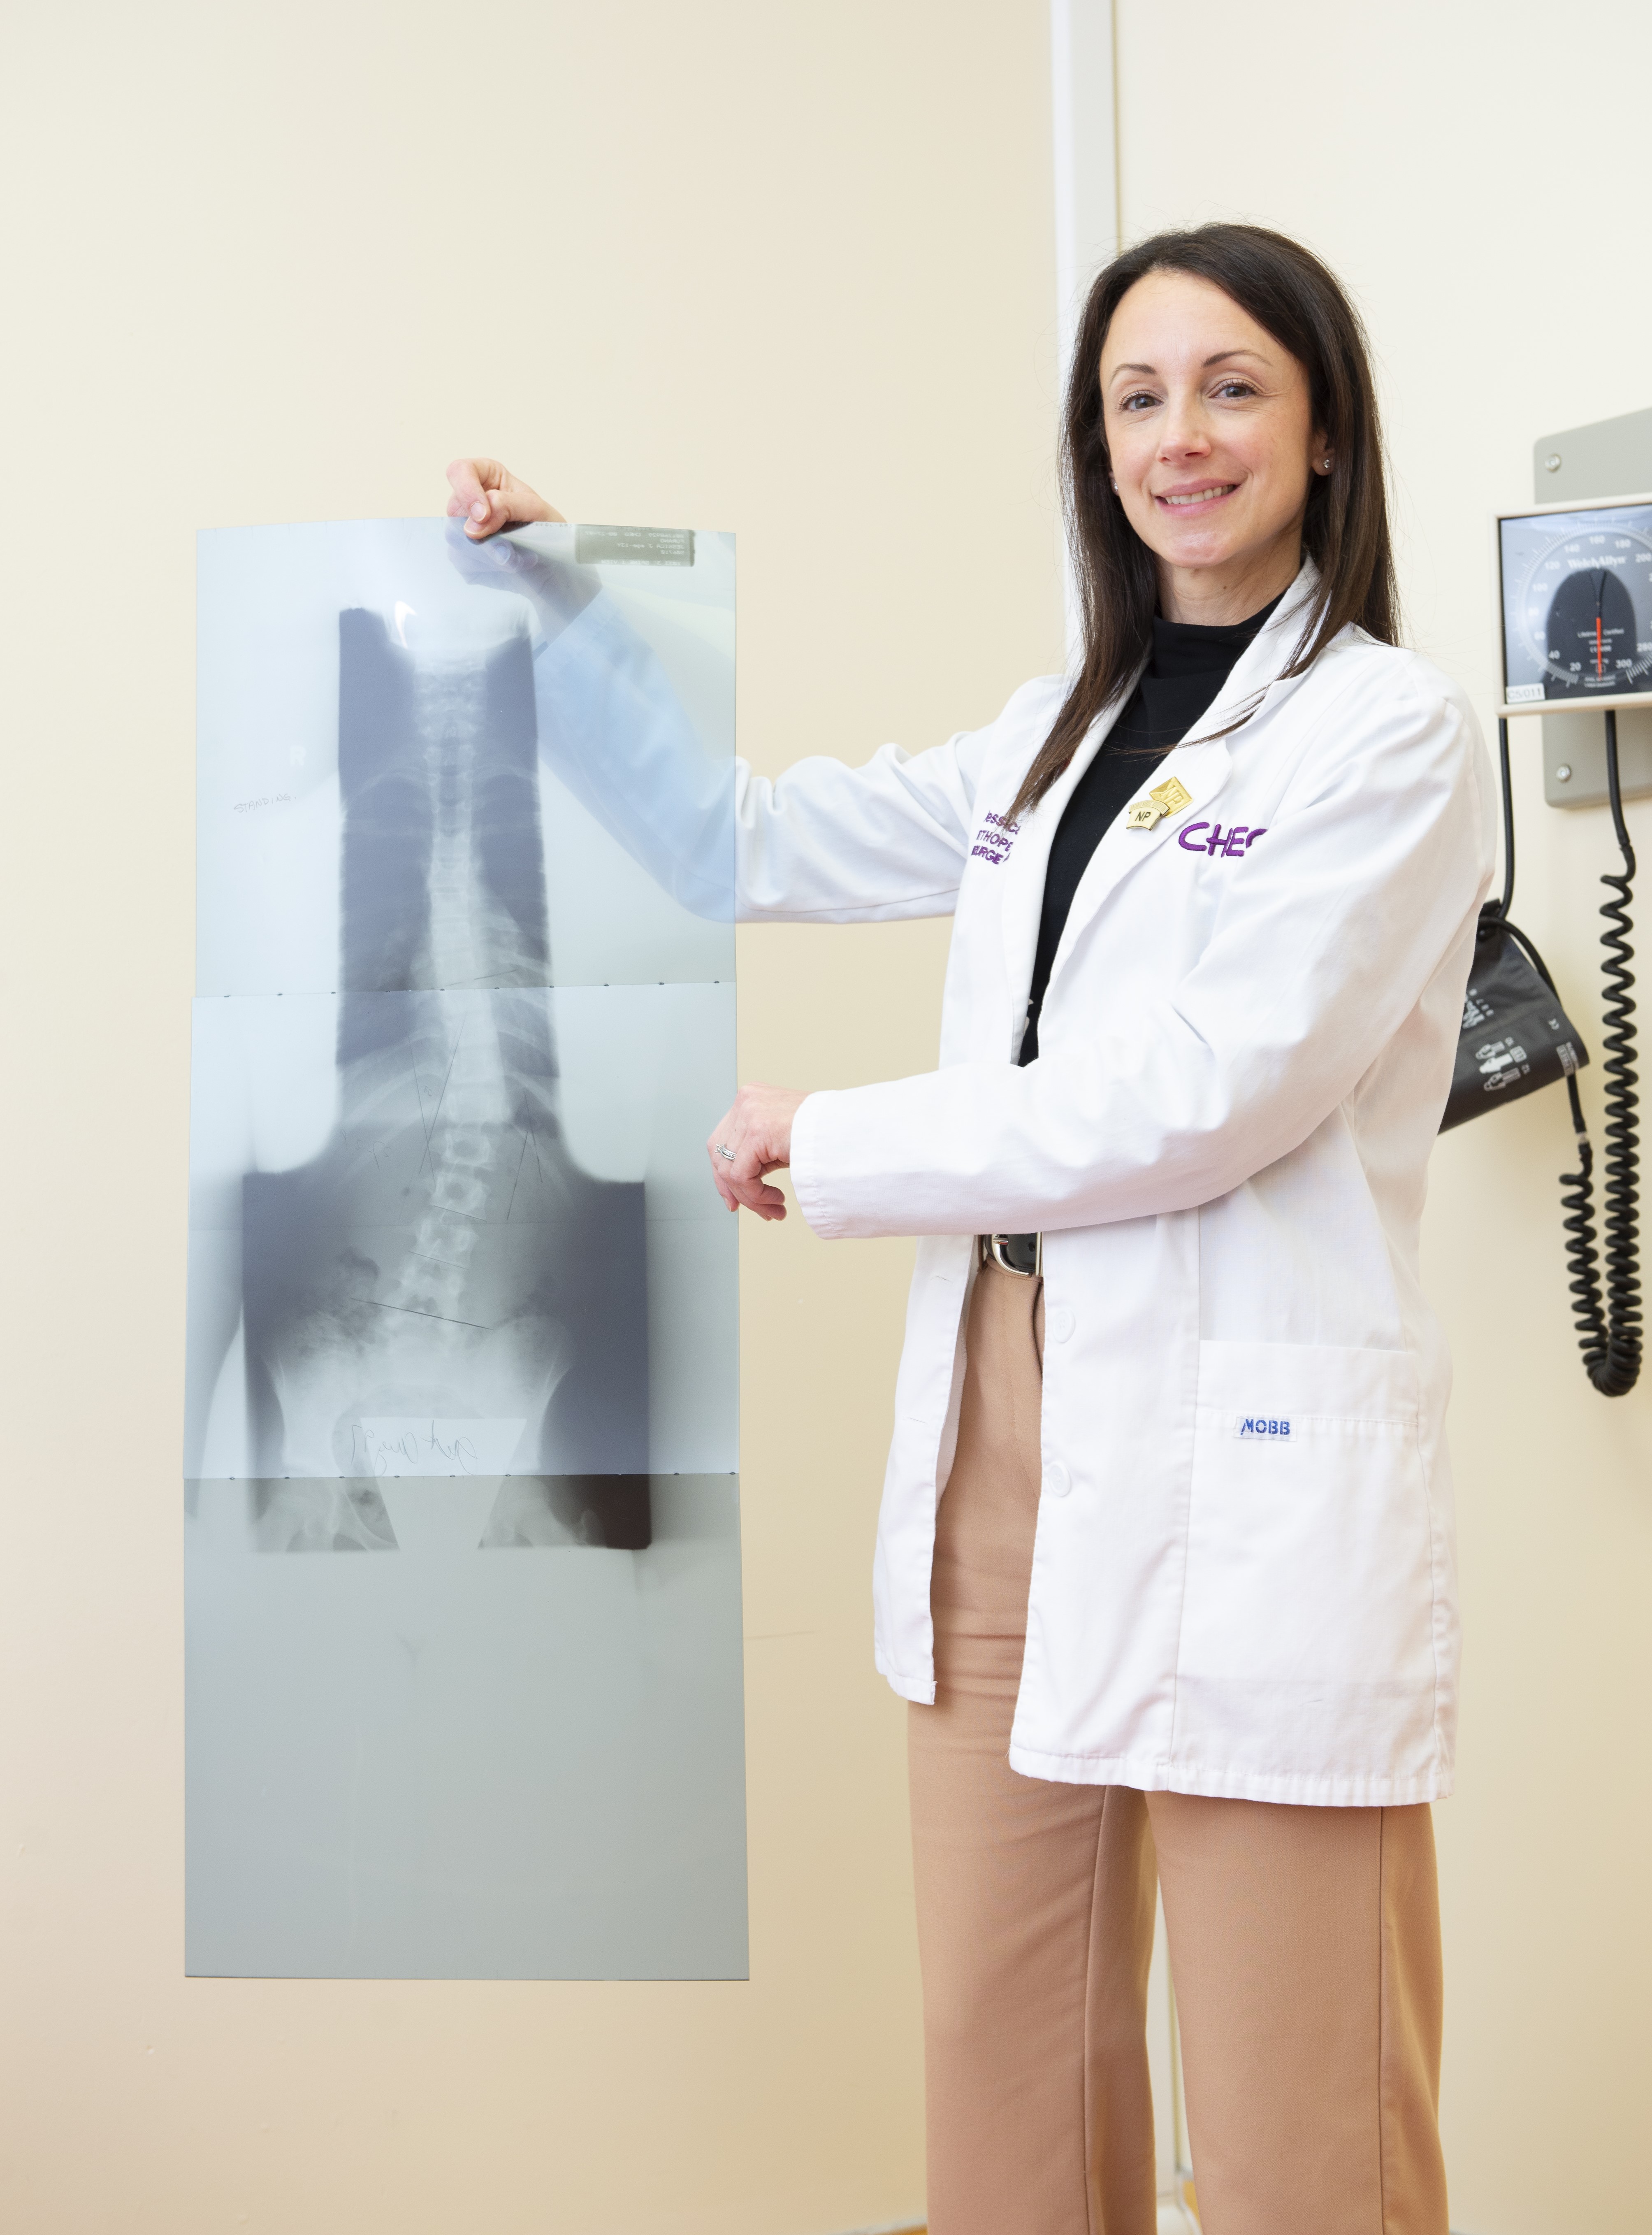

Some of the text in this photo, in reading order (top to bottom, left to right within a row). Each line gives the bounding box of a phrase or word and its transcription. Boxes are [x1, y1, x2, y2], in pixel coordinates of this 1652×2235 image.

[1549, 650, 1561, 660] 40
[1570, 661, 1582, 672] 20
[1615, 658, 1633, 669] 300
[1159, 784, 1184, 804] NP
[1135, 811, 1151, 822] NP
[1240, 1418, 1291, 1436] MOBB
